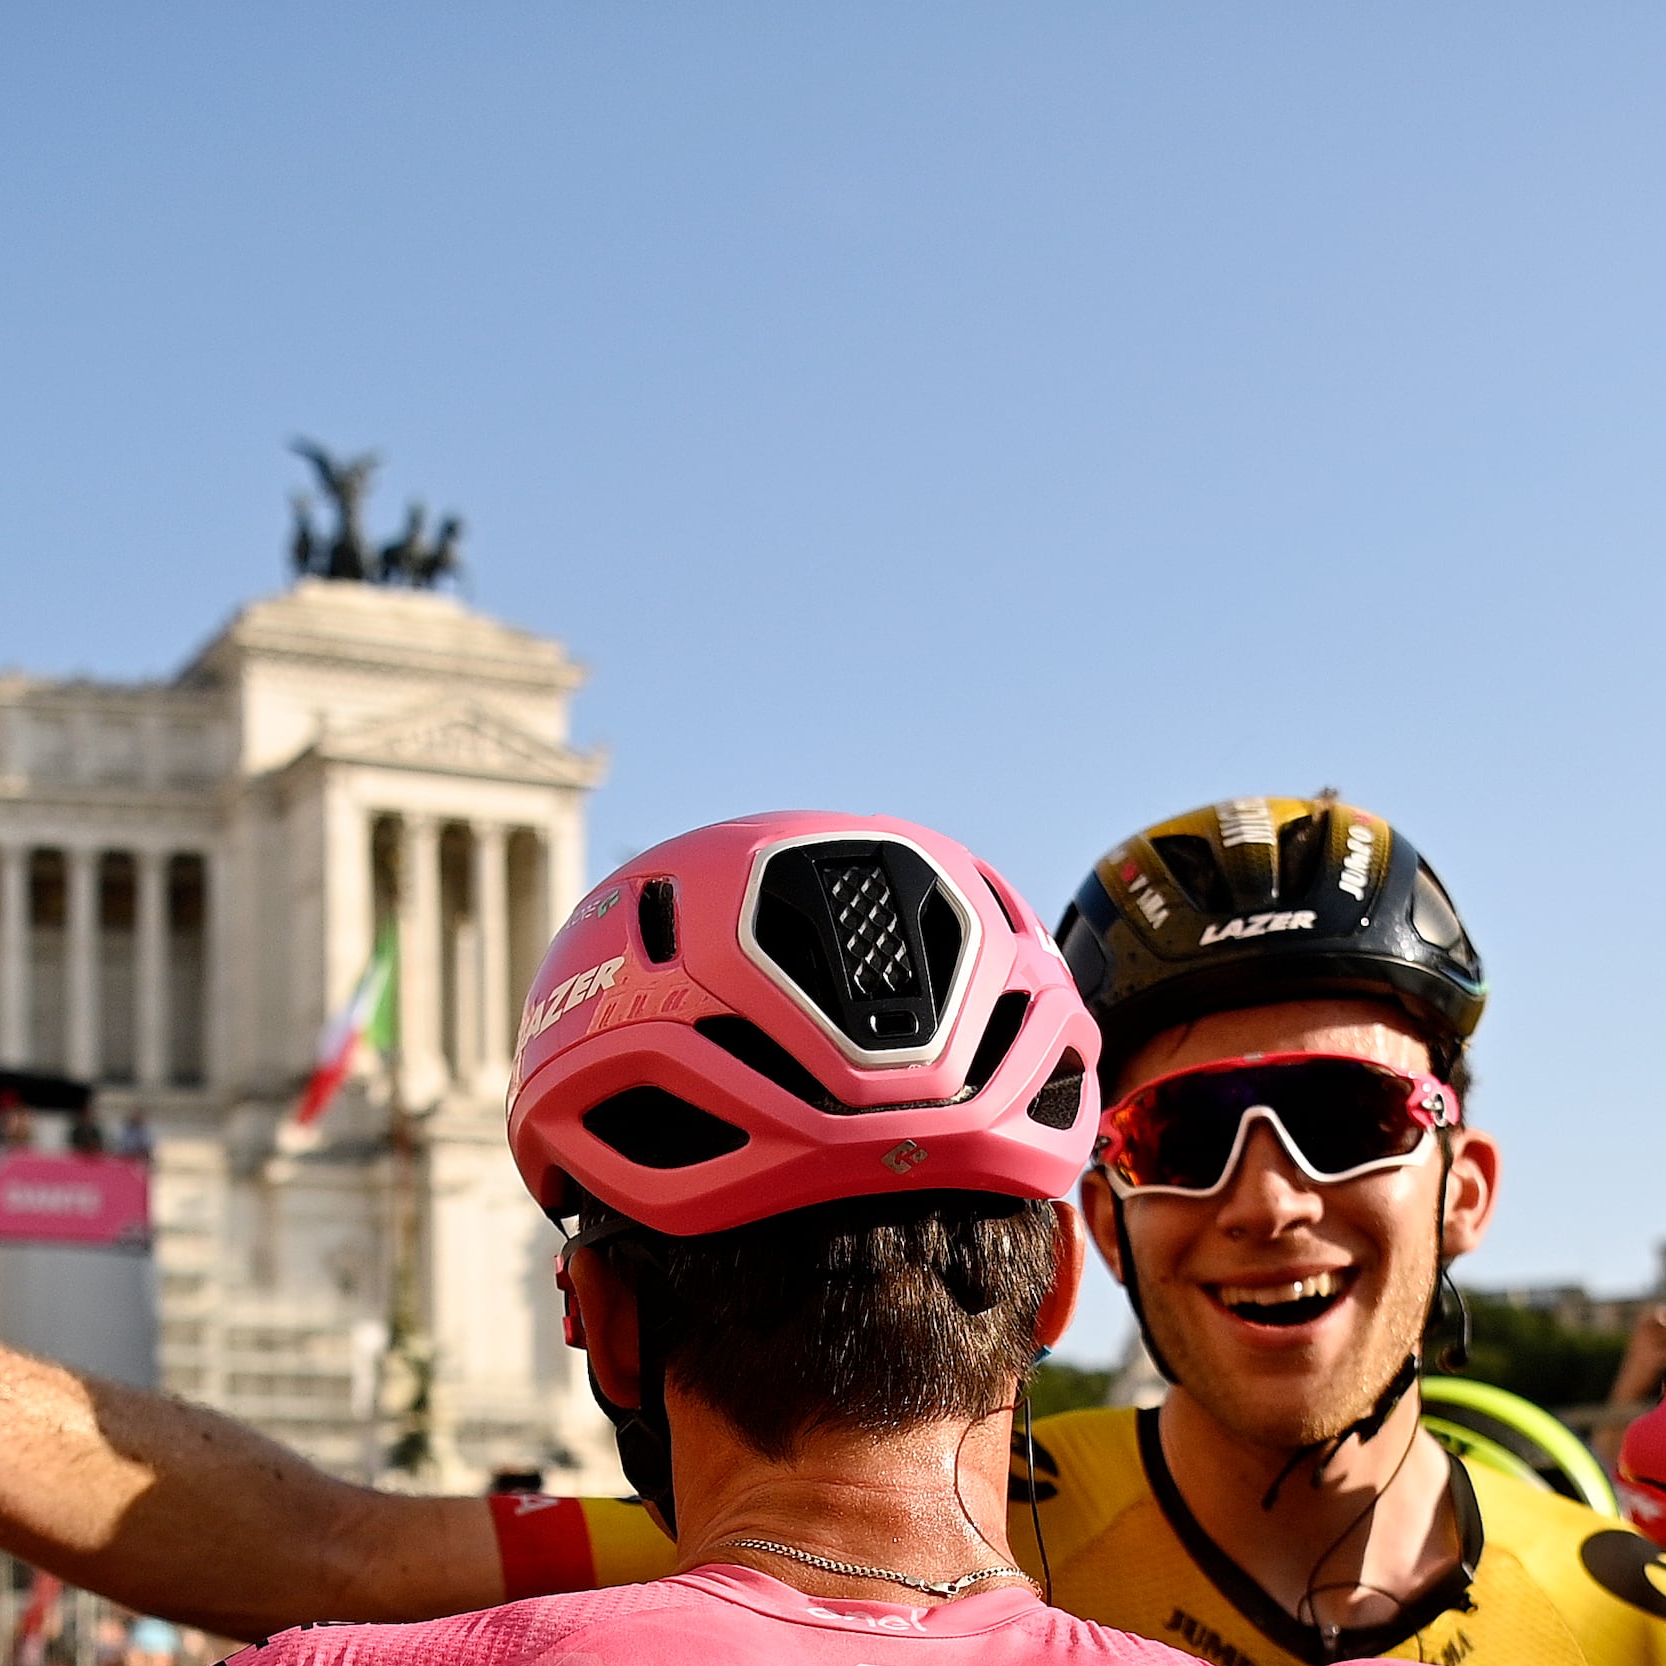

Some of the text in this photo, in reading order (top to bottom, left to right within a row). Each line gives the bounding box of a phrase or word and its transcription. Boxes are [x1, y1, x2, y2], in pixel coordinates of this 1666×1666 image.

[1199, 910, 1318, 947] LAZER
[518, 955, 626, 1052] AZER
[806, 1607, 928, 1632] enel
